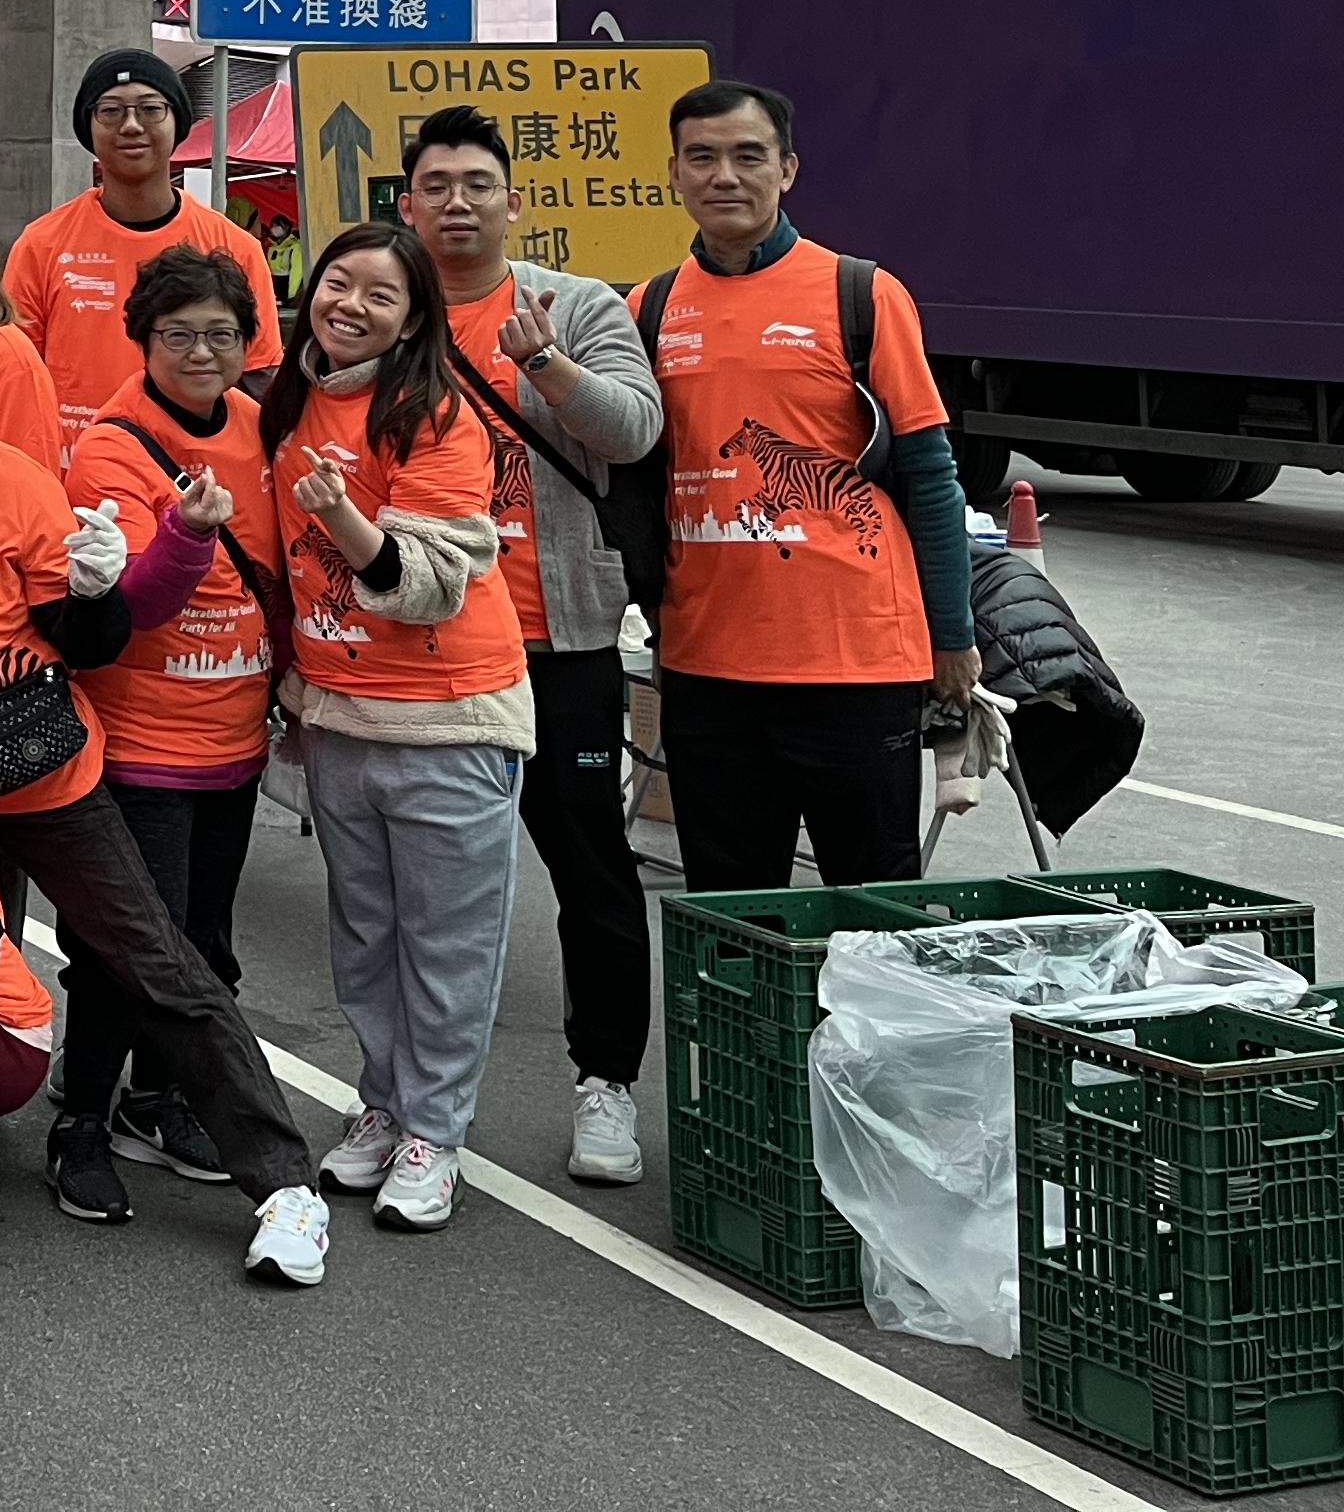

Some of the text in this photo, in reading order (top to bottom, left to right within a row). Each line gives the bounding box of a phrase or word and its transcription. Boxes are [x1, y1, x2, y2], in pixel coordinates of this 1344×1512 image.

[387, 58, 642, 93] LOHAS Park
[586, 177, 684, 208] Estat
[761, 337, 816, 348] LI-NING
[712, 467, 738, 479] Good
[208, 622, 223, 633] for
